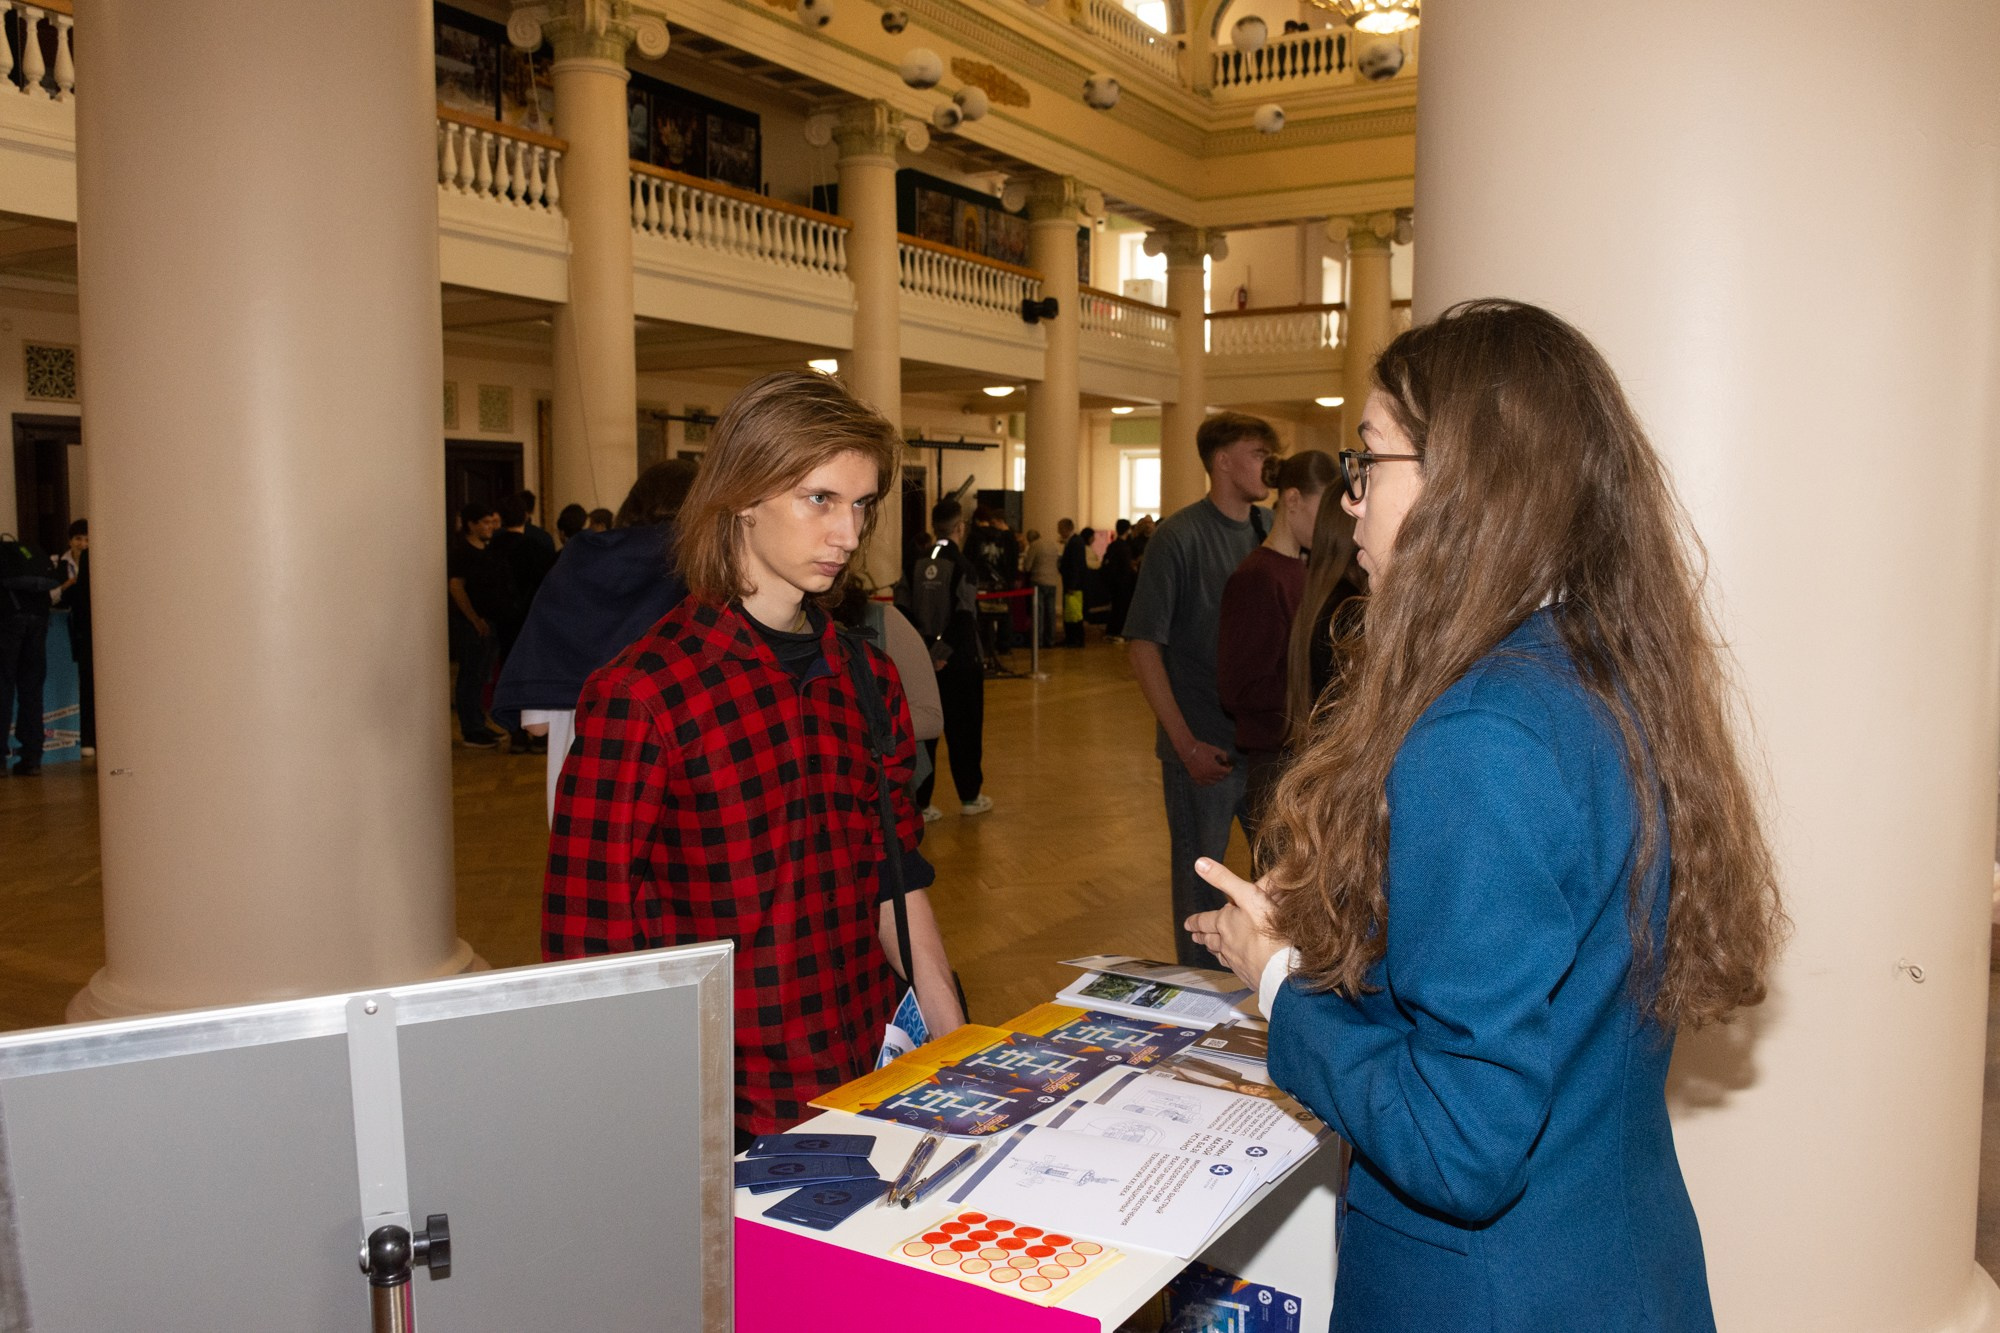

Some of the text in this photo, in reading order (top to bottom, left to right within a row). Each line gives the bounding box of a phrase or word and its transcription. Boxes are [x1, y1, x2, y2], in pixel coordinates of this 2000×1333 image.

[1179, 1132, 1200, 1150] УСТАНО
[1201, 1134, 1212, 1142] НА
[1202, 1137, 1222, 1155] МАЛОЙ
